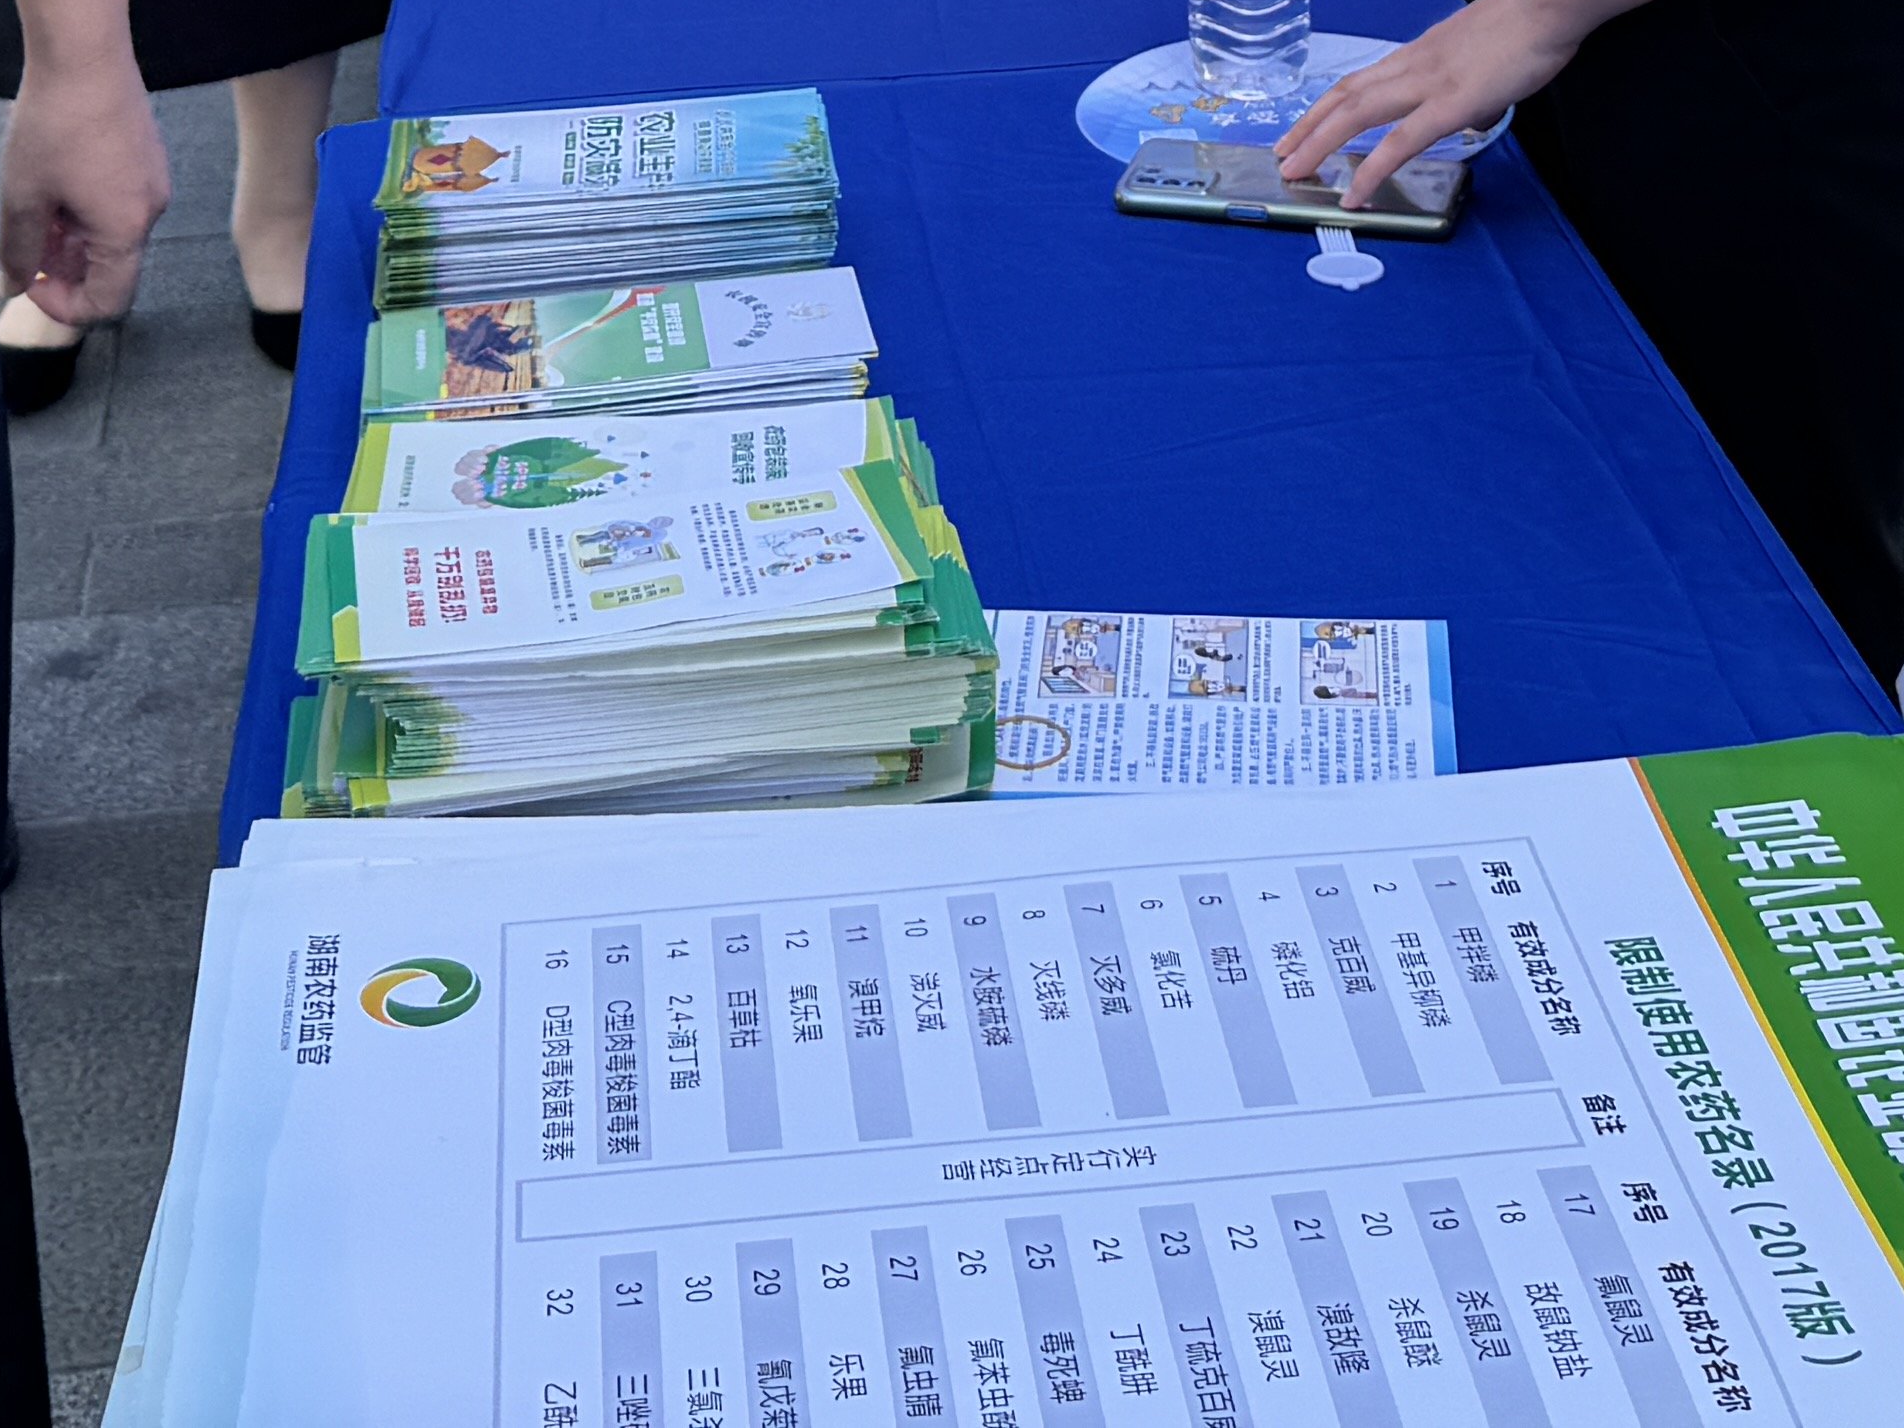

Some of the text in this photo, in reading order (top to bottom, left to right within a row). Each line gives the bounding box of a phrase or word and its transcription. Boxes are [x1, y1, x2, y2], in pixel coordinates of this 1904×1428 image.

[725, 933, 762, 1048] 13 百草枯
[786, 928, 823, 1044] 12 氧乐果
[846, 925, 885, 1038] 11 溴甲烷
[904, 917, 947, 1033] 10 涕灭威
[963, 916, 1013, 1047] 9 水胺硫磷
[1023, 909, 1069, 1022] 8 灭线磷
[1081, 904, 1132, 1015] 7 灭多威
[1140, 899, 1194, 1010] 6 氯化苦
[1198, 895, 1248, 985] 5 硫丹
[1258, 891, 1315, 1000] 4 磷化铝
[1315, 886, 1377, 995] 3 克百威
[1374, 882, 1452, 1027] 2 甲基异柳磷
[1434, 880, 1500, 983] 1 甲拌磷
[296, 934, 340, 1065] 湖南农药监管
[542, 950, 575, 1161] 16 D型肉毒梭菌毒素
[603, 943, 641, 1155] 15 C型肉毒梭菌毒素
[665, 938, 701, 1091] 14 2,4-滴丁酯
[941, 1144, 1157, 1182] 实行定点经营
[1482, 860, 1754, 1414] 序号 有效成分名称 备注 序号 有效成分名称
[546, 1288, 574, 1316] 32
[685, 1276, 712, 1302] 30
[753, 1269, 781, 1296] 29
[958, 1249, 987, 1276] 26
[1160, 1232, 1191, 1256] 23
[1227, 1225, 1300, 1382] 22 溴鼠灵
[1294, 1218, 1370, 1375] 21 溴敌隆
[1361, 1212, 1441, 1368] 20 杀鼠醚
[1428, 1207, 1512, 1360] 19 杀鼠灵
[1495, 1200, 1593, 1379] 18 敌鼠钠盐
[1564, 1194, 1654, 1346] 17 氟鼠灵
[615, 1282, 651, 1428] 31 三唑
[822, 1262, 867, 1400] 28 乐果
[889, 1255, 942, 1418] 27 氟虫腈
[1026, 1244, 1086, 1404] 25 毒死蜱
[1093, 1238, 1159, 1396] 24 丁酰肼
